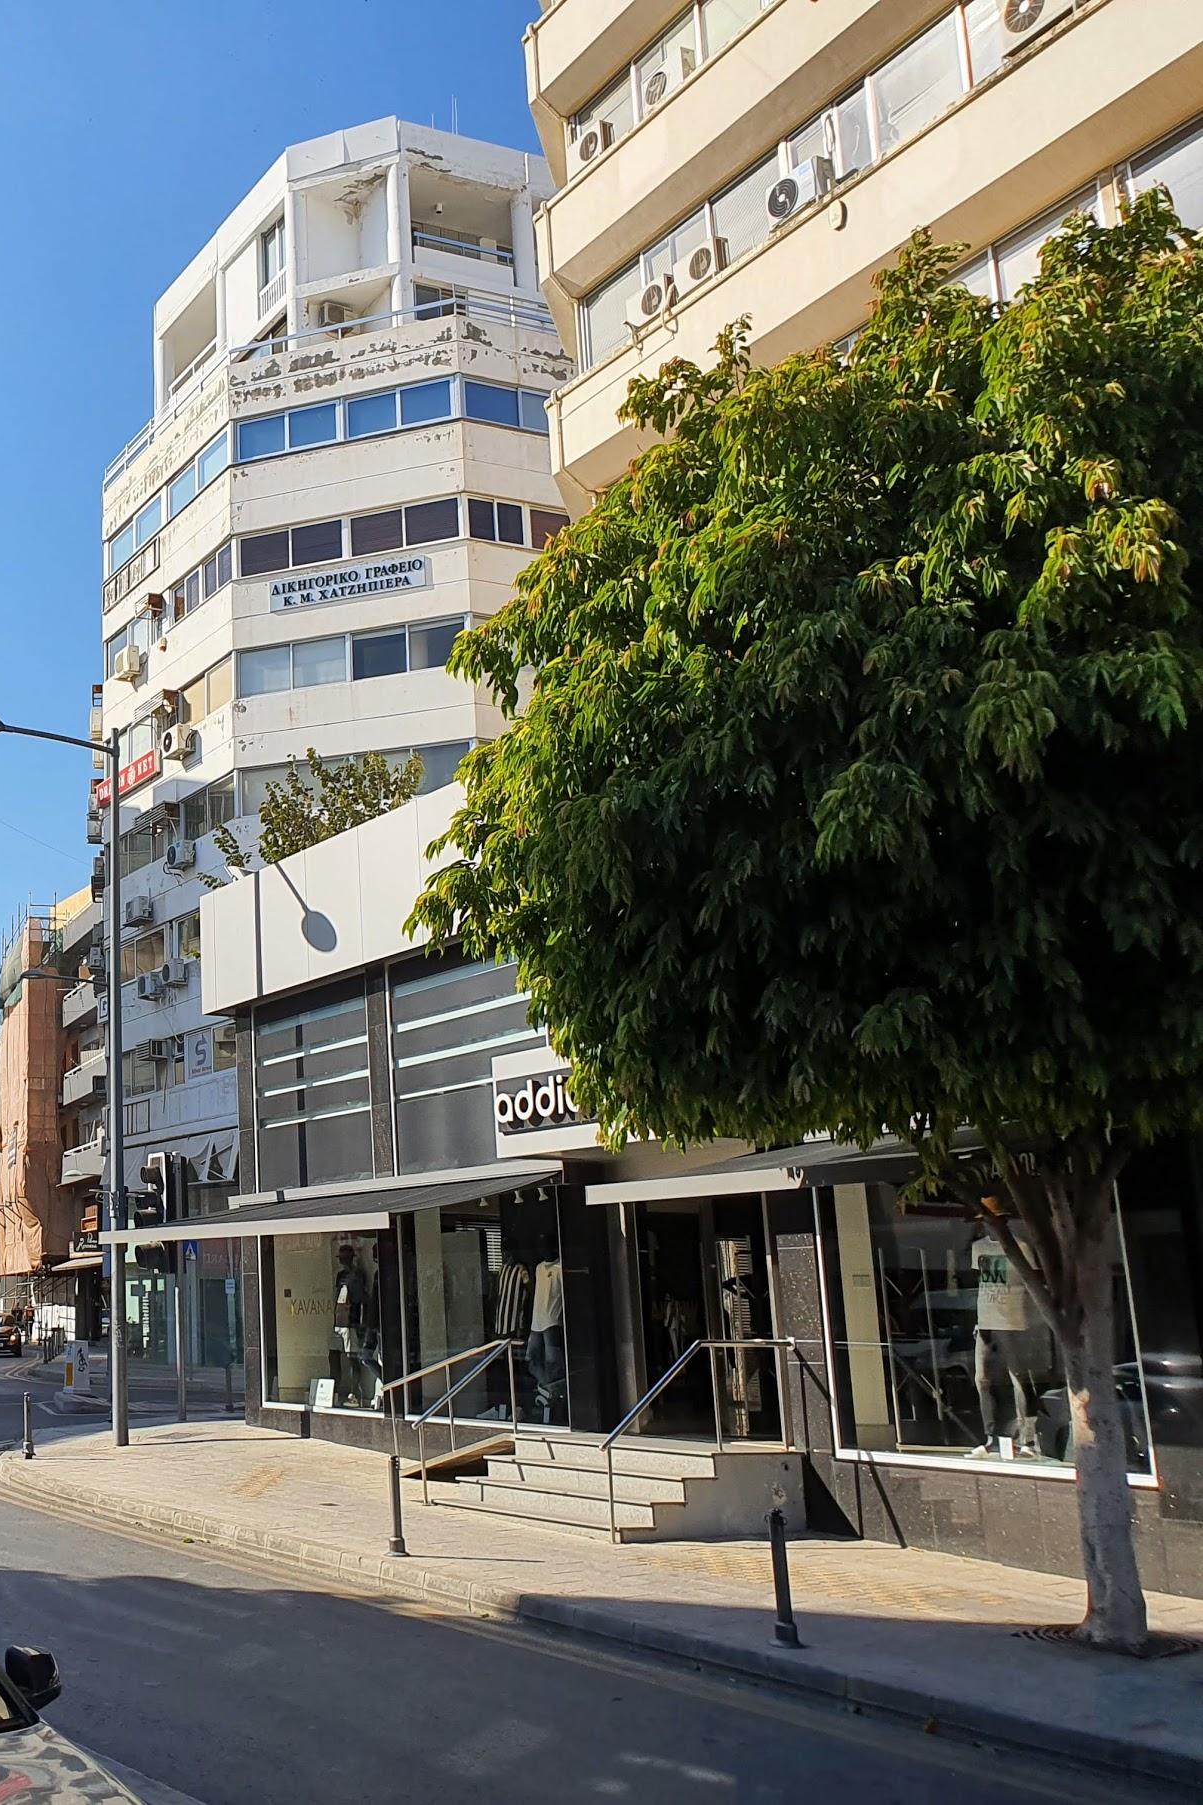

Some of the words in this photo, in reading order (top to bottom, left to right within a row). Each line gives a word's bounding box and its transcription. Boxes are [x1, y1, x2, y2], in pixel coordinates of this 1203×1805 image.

[271, 571, 359, 596] ΔΙΚΗΓΟΡΙΚΟ
[365, 559, 422, 580] ΓΡΑΦΕΙΟ
[318, 575, 411, 601] ΧΑΤΖΗΠΙΕΡΑ
[99, 773, 125, 800] DRAN
[137, 755, 153, 777] NET
[494, 1075, 580, 1123] addic
